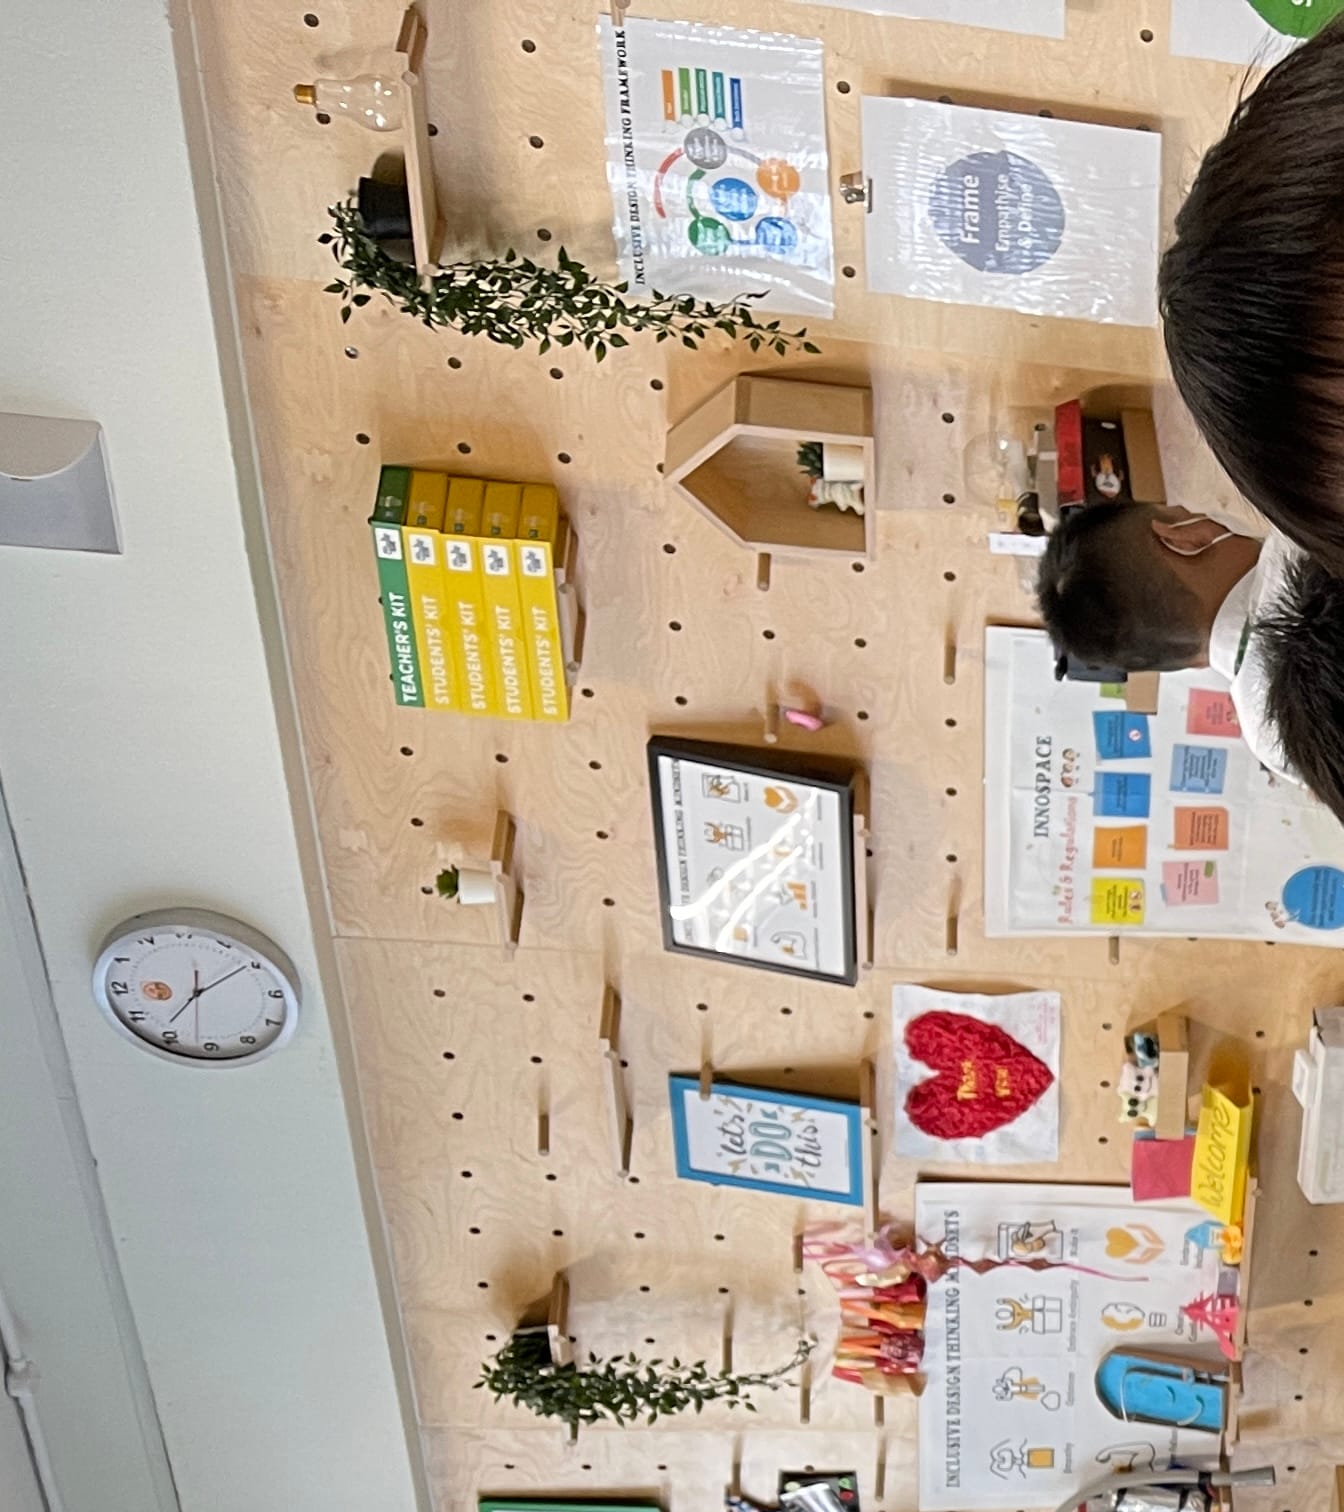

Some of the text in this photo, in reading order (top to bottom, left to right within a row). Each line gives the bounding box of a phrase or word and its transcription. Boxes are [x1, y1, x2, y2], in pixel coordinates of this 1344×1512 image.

[614, 30, 631, 115] FRAMEWORK
[960, 174, 980, 244] Frame
[994, 174, 1014, 252] Empathise
[1017, 183, 1032, 232] Define
[630, 224, 646, 284] INCLUSIVE
[388, 592, 418, 702] TEACHER'S KIT
[422, 595, 450, 704] STUDENTS' KIT
[458, 601, 486, 710] STUDENTS' KIT
[495, 606, 522, 714] STUDENTS' KIT
[532, 606, 558, 715] STUDENTS' KIT
[1034, 736, 1052, 838] INNOSPACE
[1059, 796, 1078, 872] Regulations
[1058, 888, 1074, 924] Rules
[111, 982, 128, 997] 12
[128, 1010, 144, 1023] 11
[265, 1018, 281, 1026] 7
[268, 989, 284, 998] 6
[162, 1030, 178, 1046] 10
[204, 1042, 220, 1052] 9
[239, 1036, 256, 1044] 8
[748, 1121, 792, 1162] DO
[1198, 1102, 1234, 1208] Welcome
[945, 1288, 960, 1362] THINKING
[946, 1364, 961, 1416] DESIGN
[946, 1417, 962, 1488] INCLUSIVE
